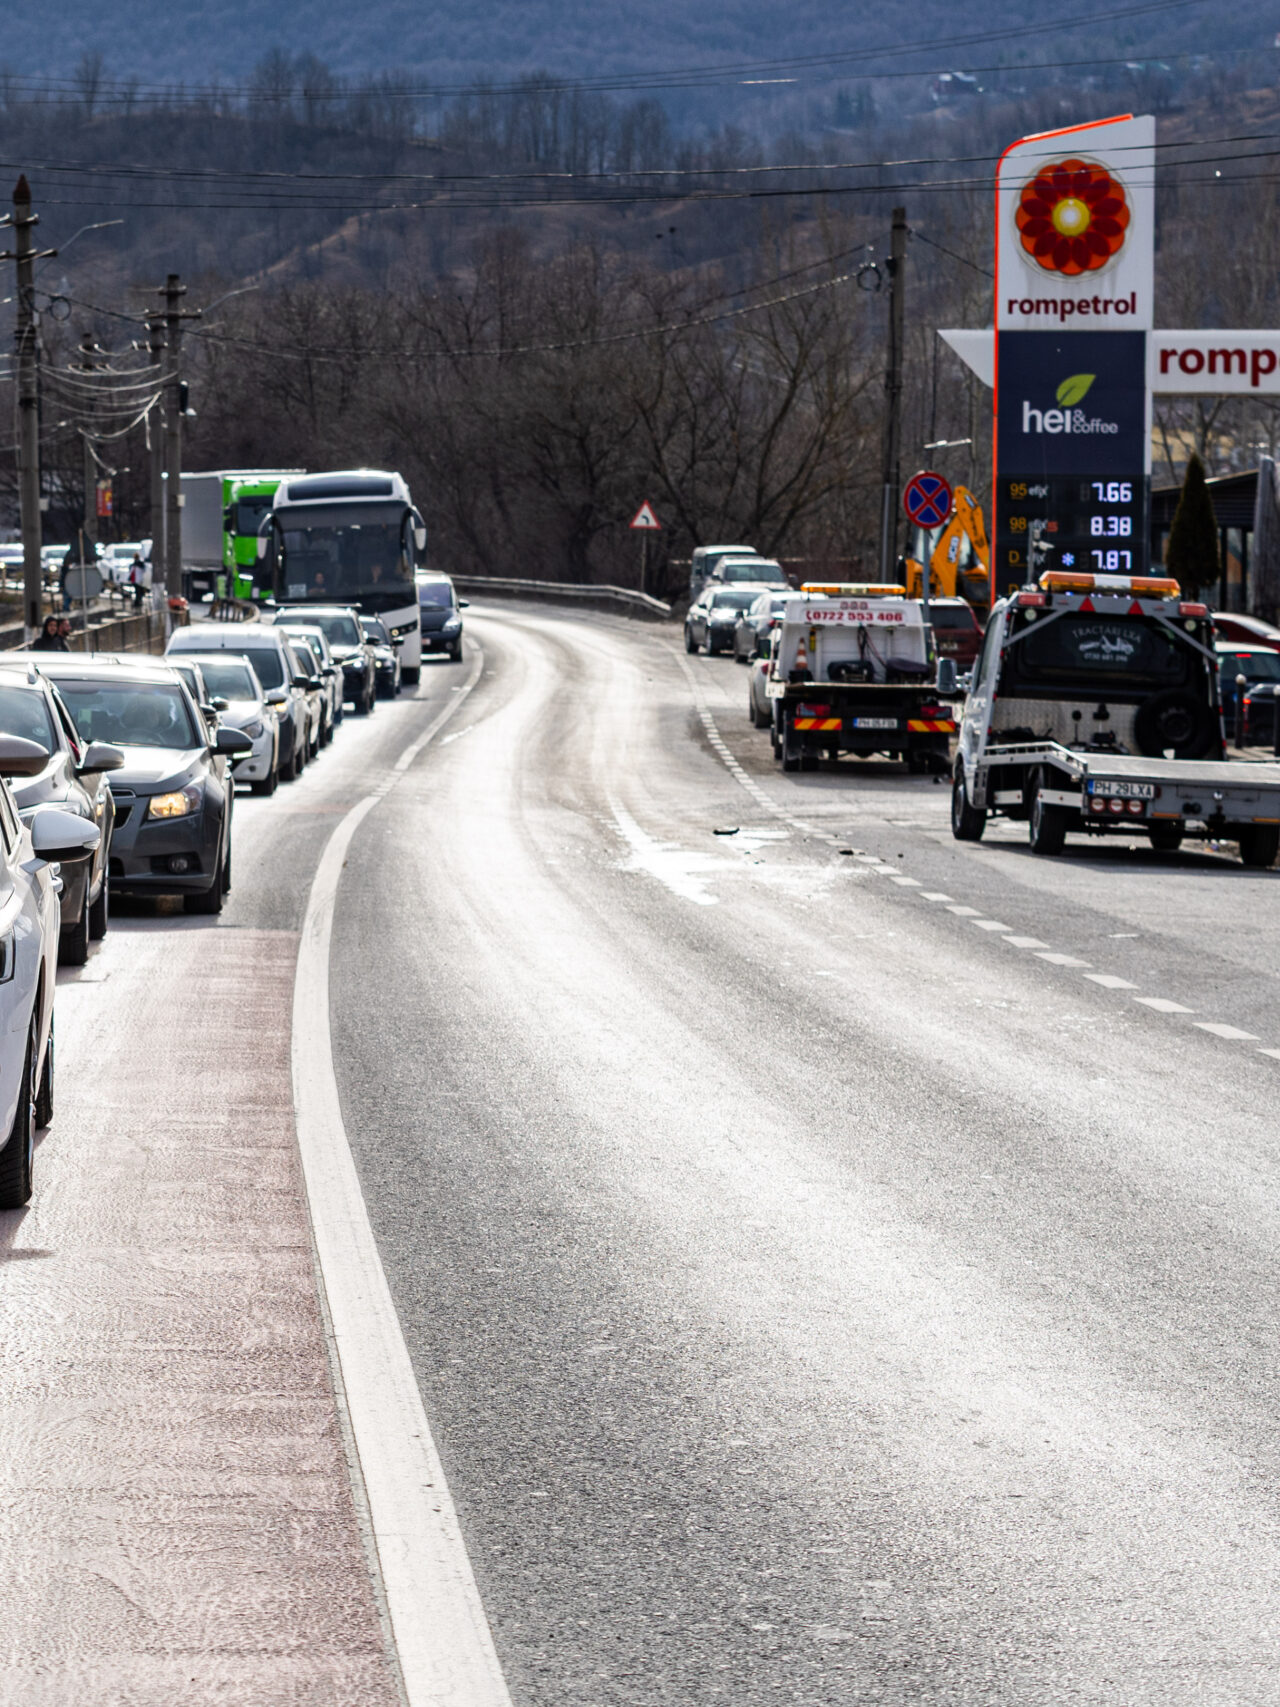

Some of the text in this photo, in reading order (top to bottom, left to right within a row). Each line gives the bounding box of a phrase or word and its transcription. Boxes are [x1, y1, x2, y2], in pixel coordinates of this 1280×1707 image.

[1008, 292, 1137, 322] rompetrol
[1160, 348, 1280, 388] romp
[1073, 418, 1119, 434] coffee
[1009, 483, 1028, 497] 95
[1091, 482, 1132, 502] 7.66
[1009, 517, 1028, 531] 98
[1091, 516, 1131, 536] 8.38
[1008, 550, 1020, 564] D
[1091, 549, 1131, 570] 7.87
[813, 610, 844, 621] 0722
[1094, 781, 1112, 794] PH
